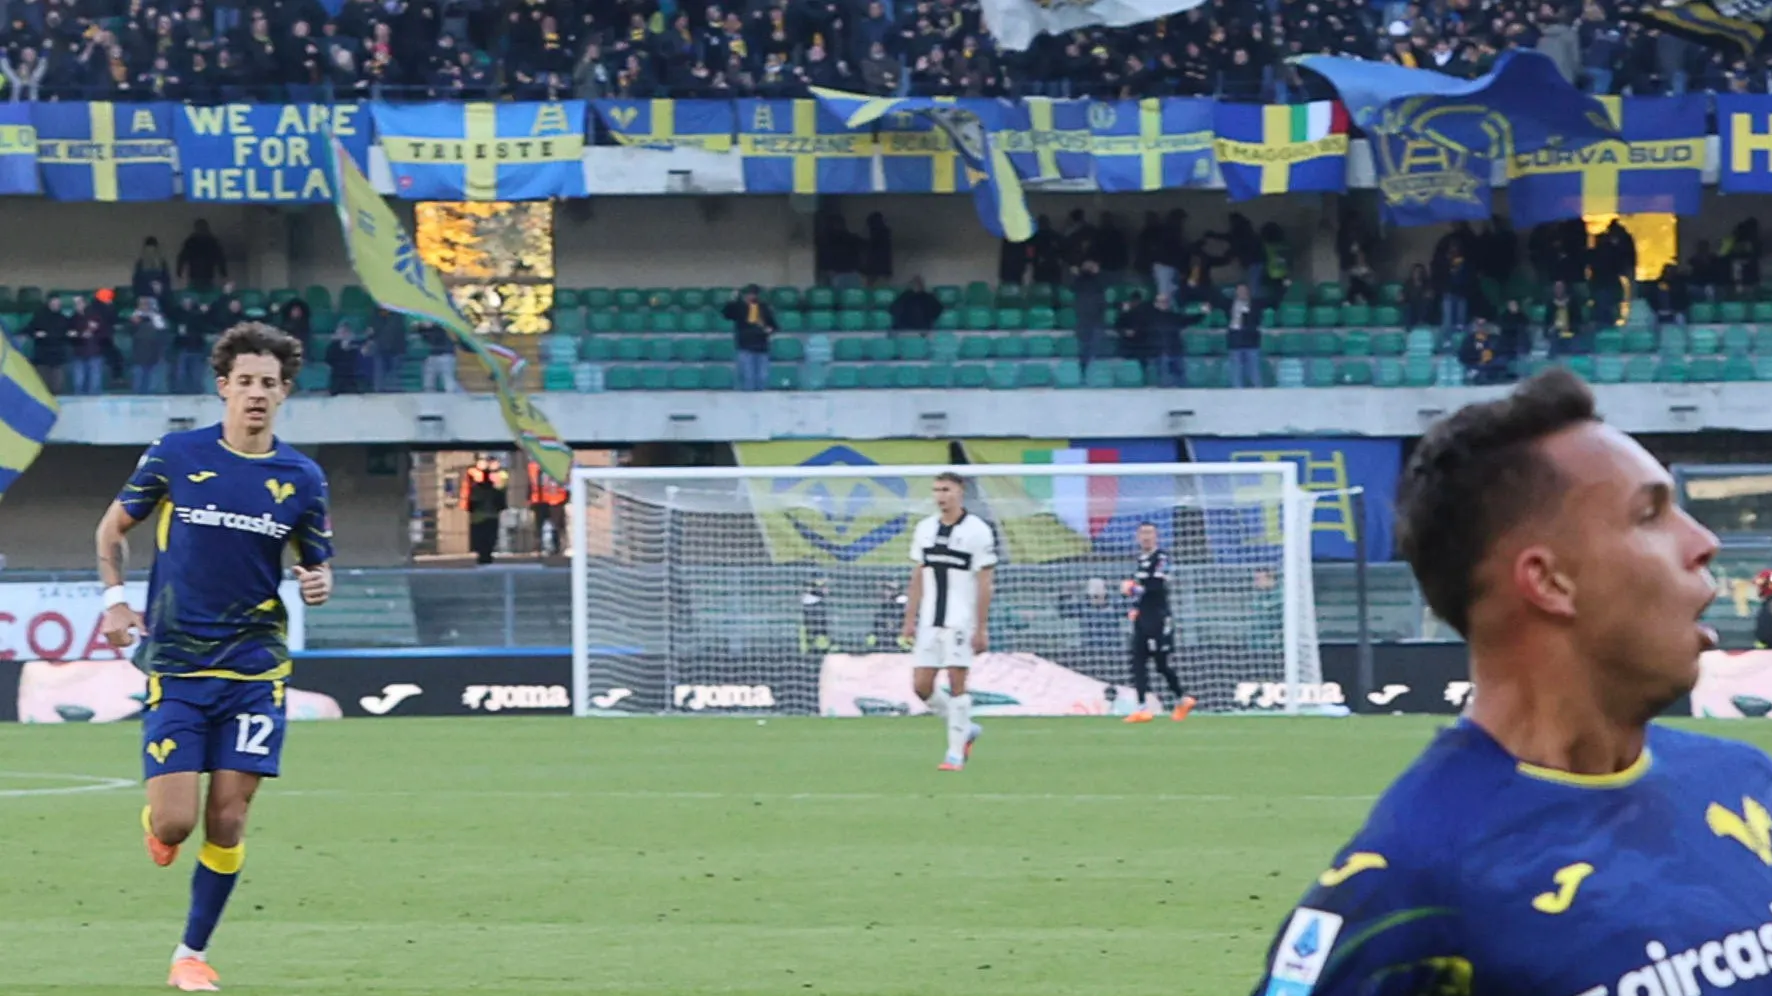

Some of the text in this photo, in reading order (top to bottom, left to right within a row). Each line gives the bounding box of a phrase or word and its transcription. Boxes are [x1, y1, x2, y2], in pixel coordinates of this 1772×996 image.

[184, 103, 360, 136] WE ARE
[233, 136, 312, 167] FOR
[408, 141, 554, 159] TRIESTE
[1514, 144, 1693, 168] CURVA SUD
[191, 168, 332, 199] HELLA
[190, 504, 278, 537] aircash
[234, 712, 274, 756] 12
